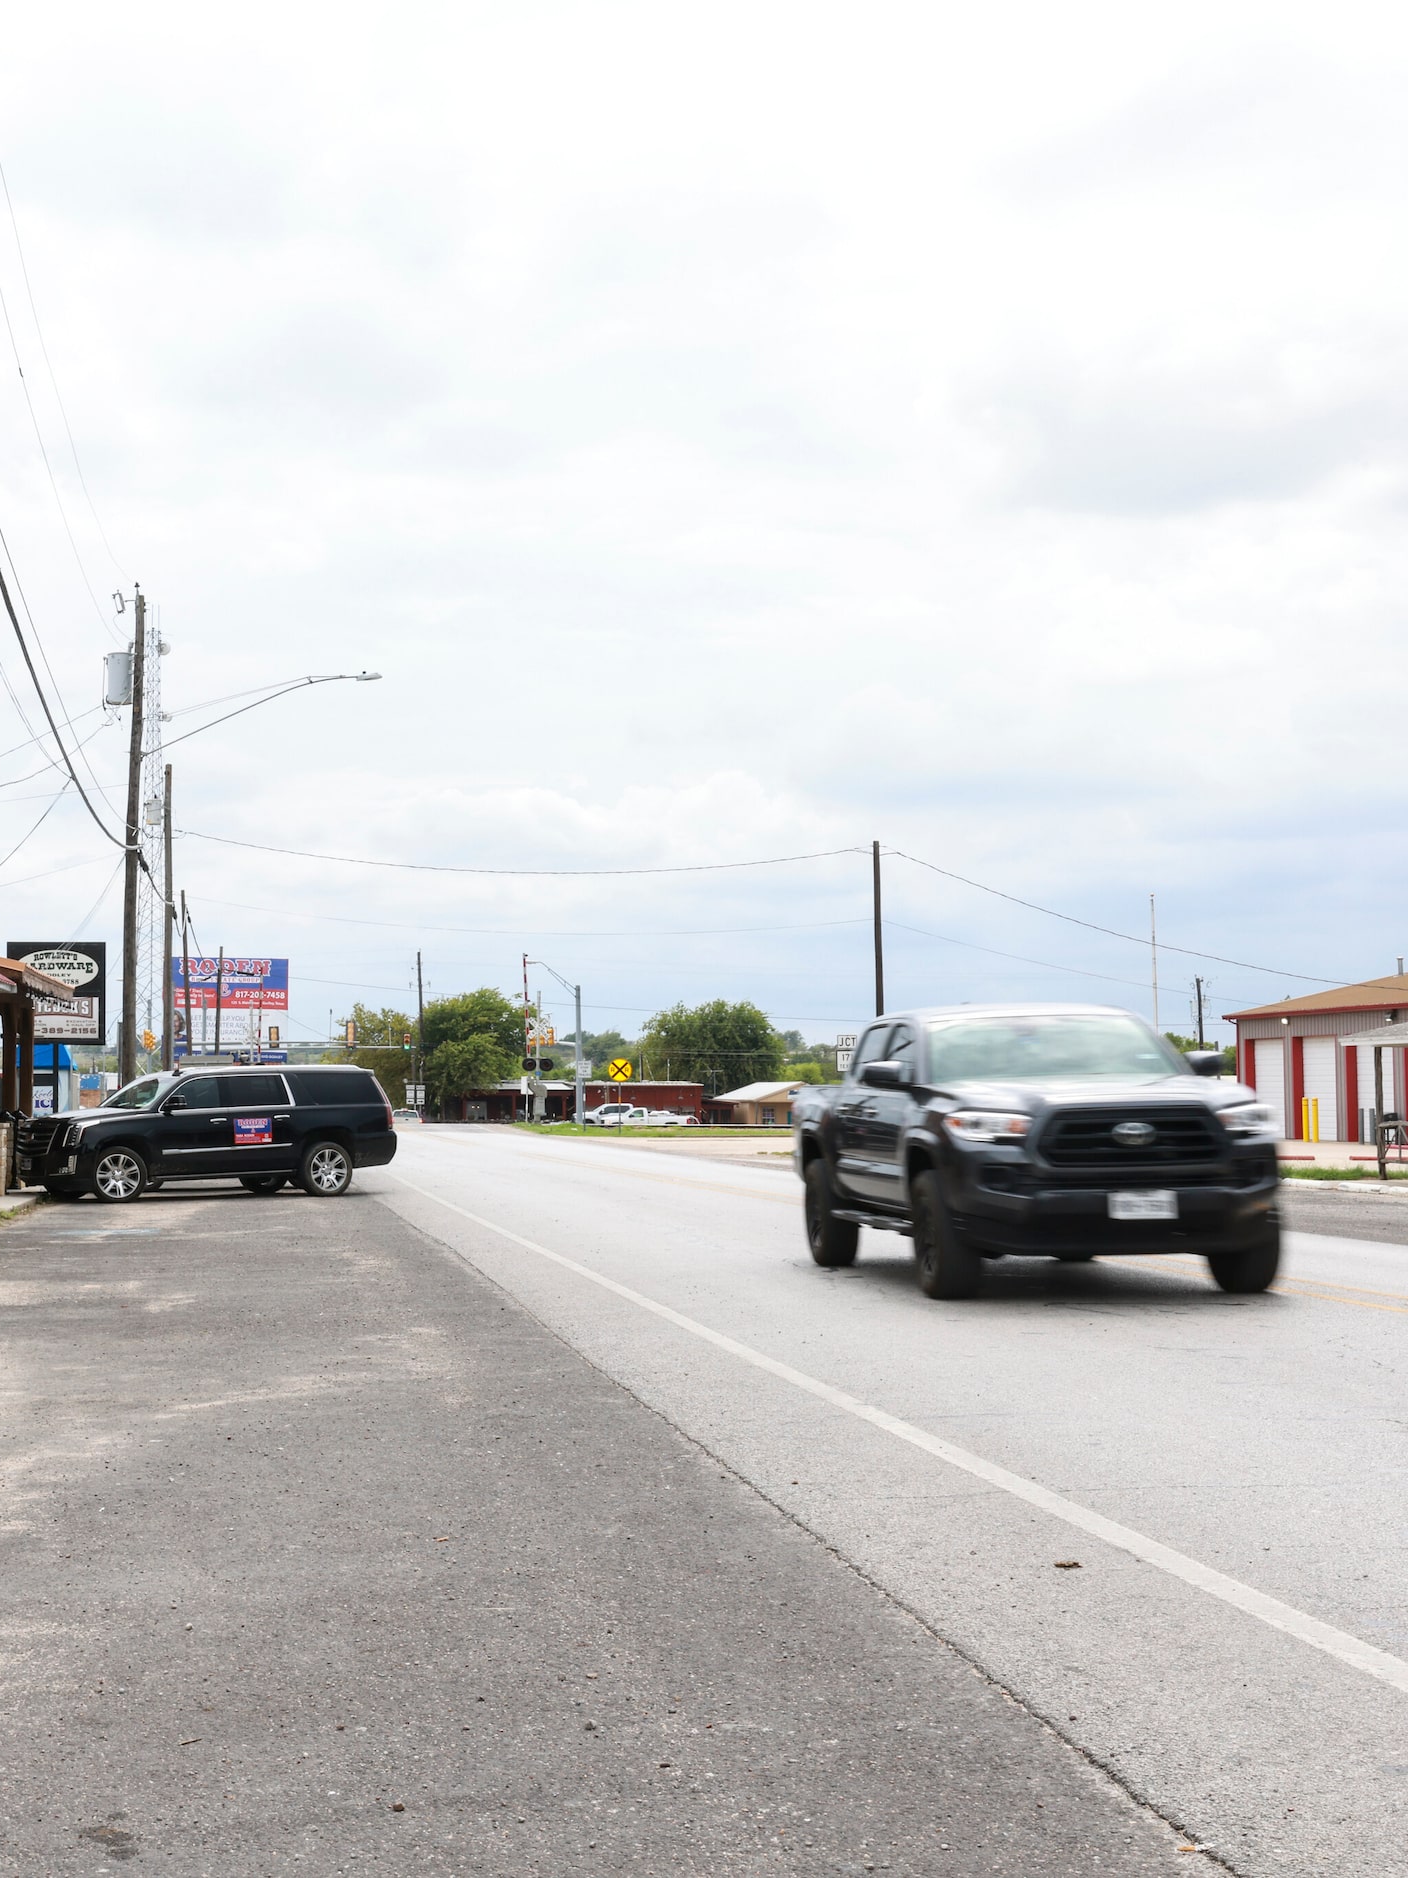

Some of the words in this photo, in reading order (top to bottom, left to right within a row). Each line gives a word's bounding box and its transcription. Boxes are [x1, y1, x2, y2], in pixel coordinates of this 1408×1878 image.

[29, 962, 94, 974] ARDWARE
[179, 958, 272, 976] RODEN
[839, 1037, 856, 1047] JCT
